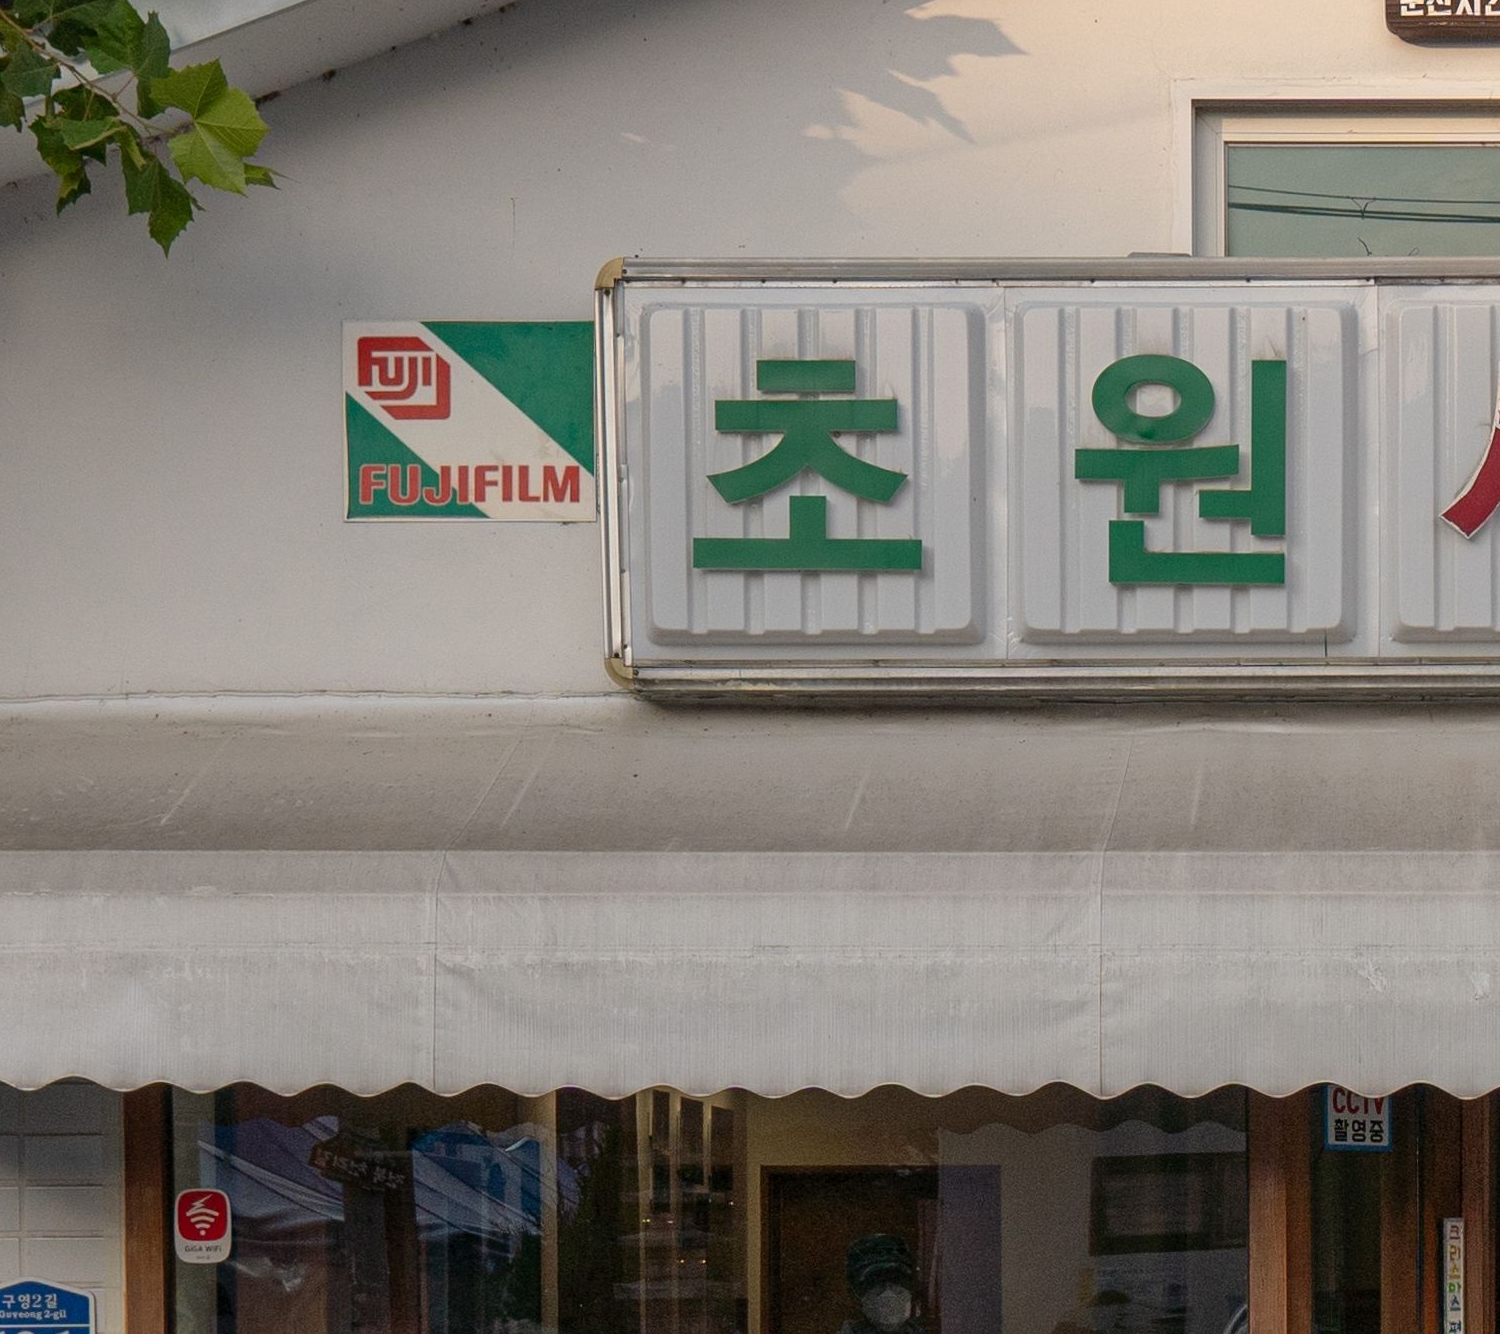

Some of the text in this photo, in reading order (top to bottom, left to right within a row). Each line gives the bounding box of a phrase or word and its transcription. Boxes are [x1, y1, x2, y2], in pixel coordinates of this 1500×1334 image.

[359, 463, 580, 508] FUJIFILM
[1333, 1119, 1386, 1143] 촬영중
[1446, 1223, 1463, 1312] 크리스마스
[2, 1293, 58, 1310] 구영2길
[43, 1310, 67, 1321] 2-gil
